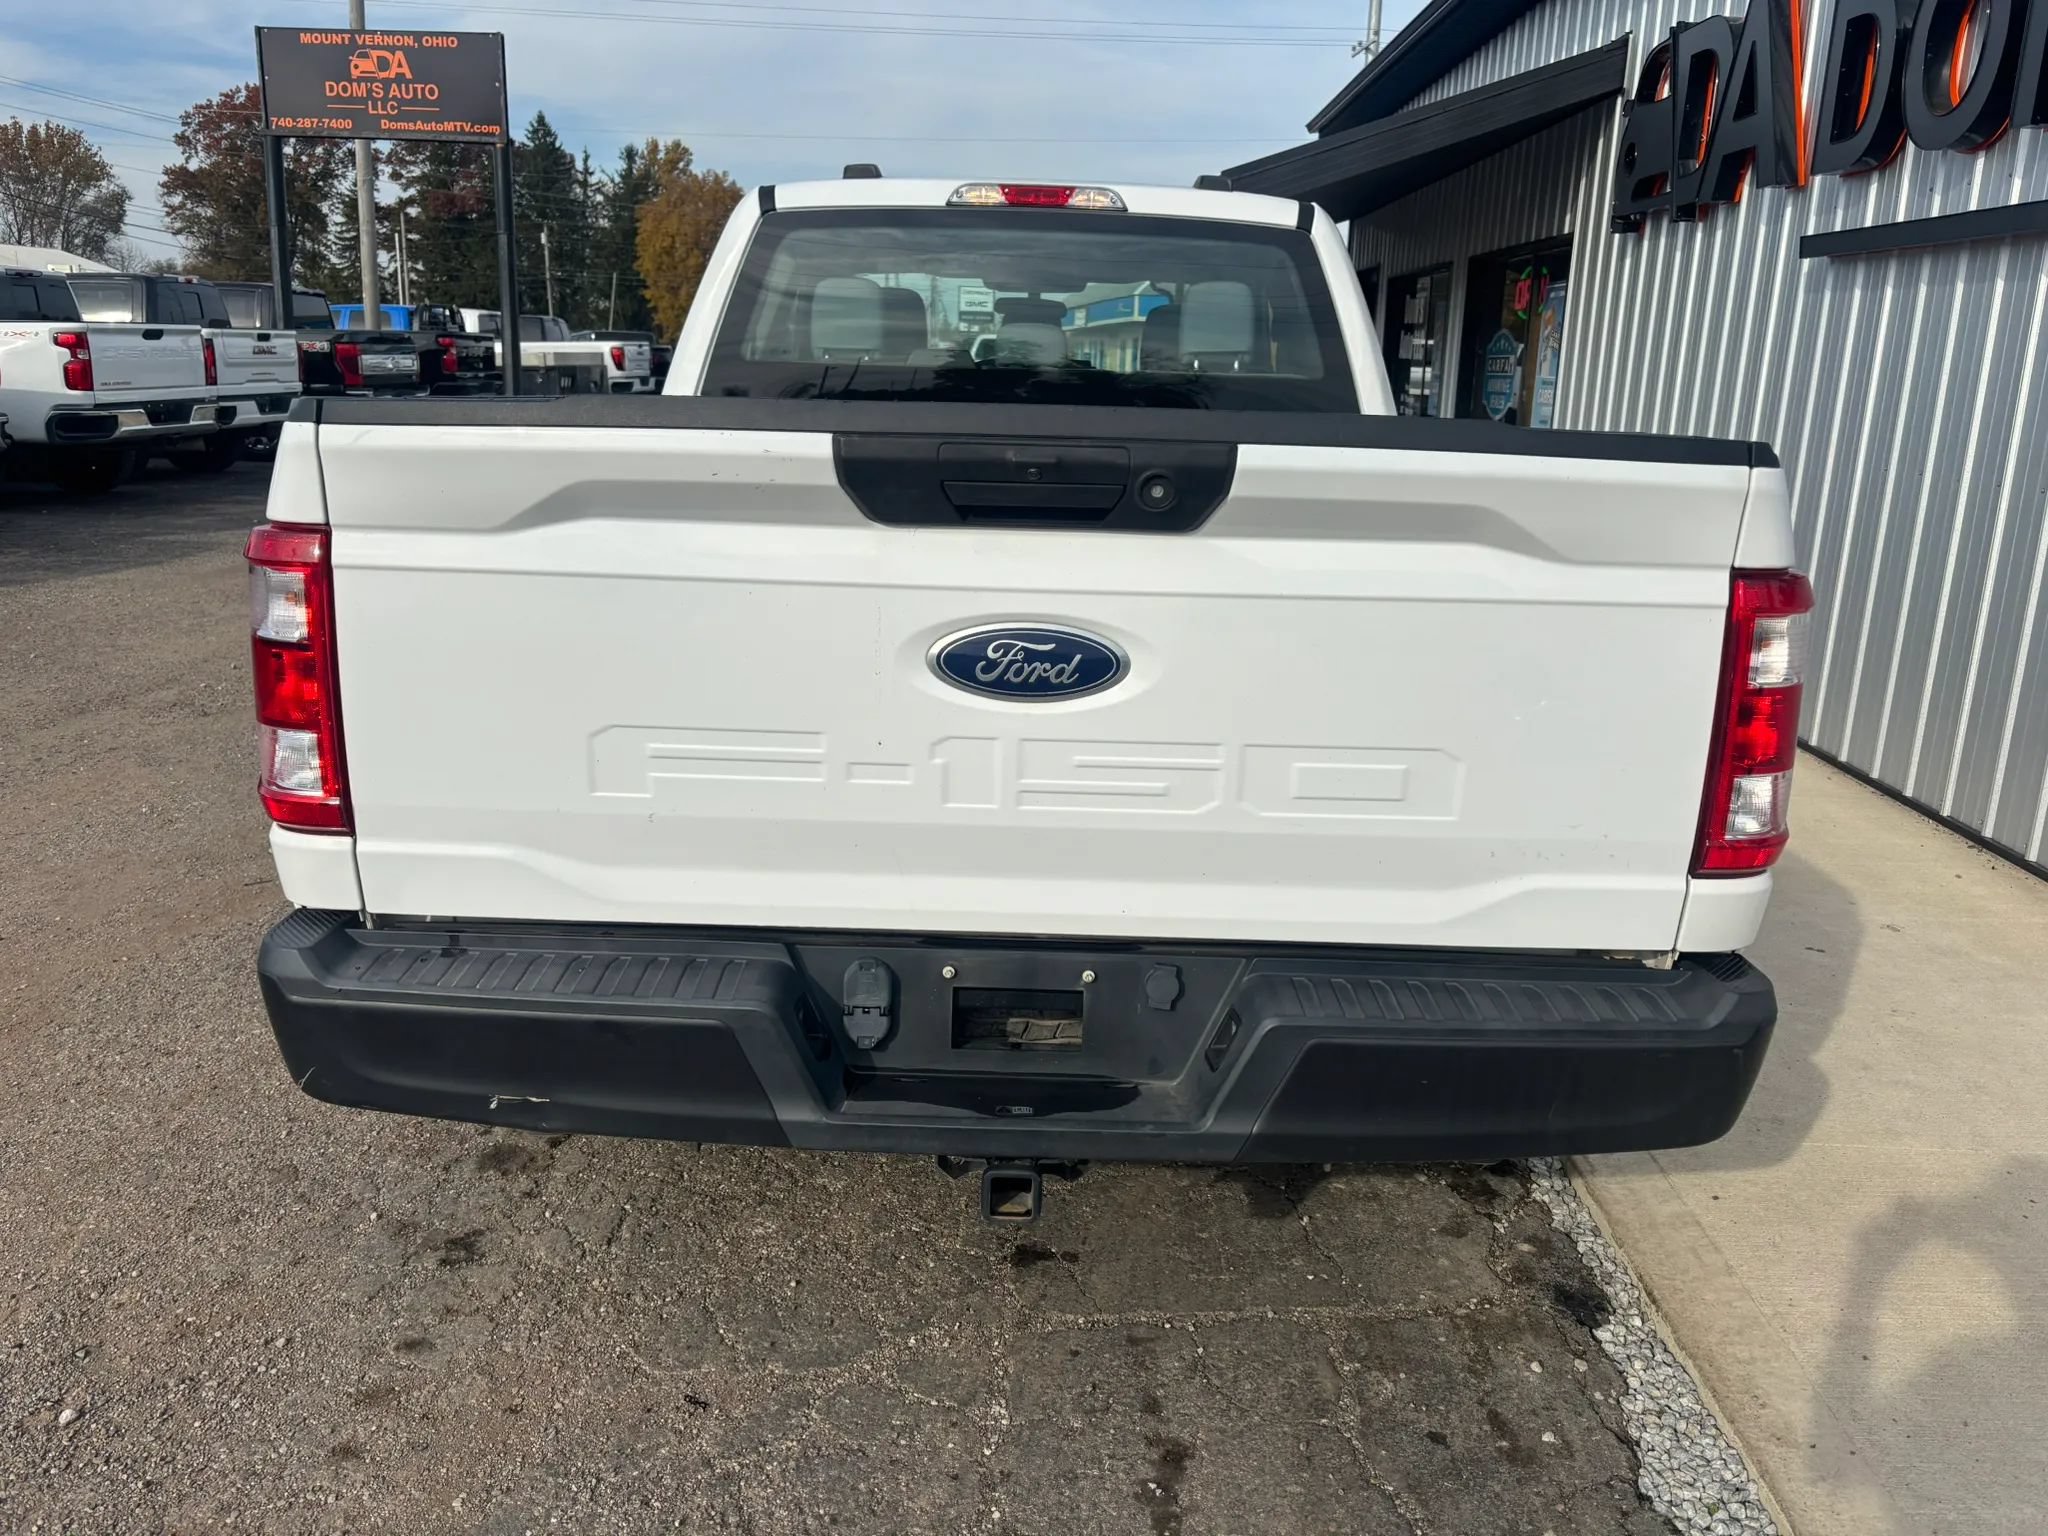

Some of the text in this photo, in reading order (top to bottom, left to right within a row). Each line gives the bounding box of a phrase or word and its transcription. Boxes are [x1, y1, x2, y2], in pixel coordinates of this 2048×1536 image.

[300, 33, 458, 48] MOUNT VERNON, OHIO
[325, 81, 439, 100] DOM'S AUTO
[1811, 0, 2048, 174] DO
[367, 101, 399, 115] LLC
[270, 117, 501, 135] 740-287-7400 DomsAutoMTV.com
[975, 640, 1083, 682] Ford
[588, 724, 1467, 821] F-150
